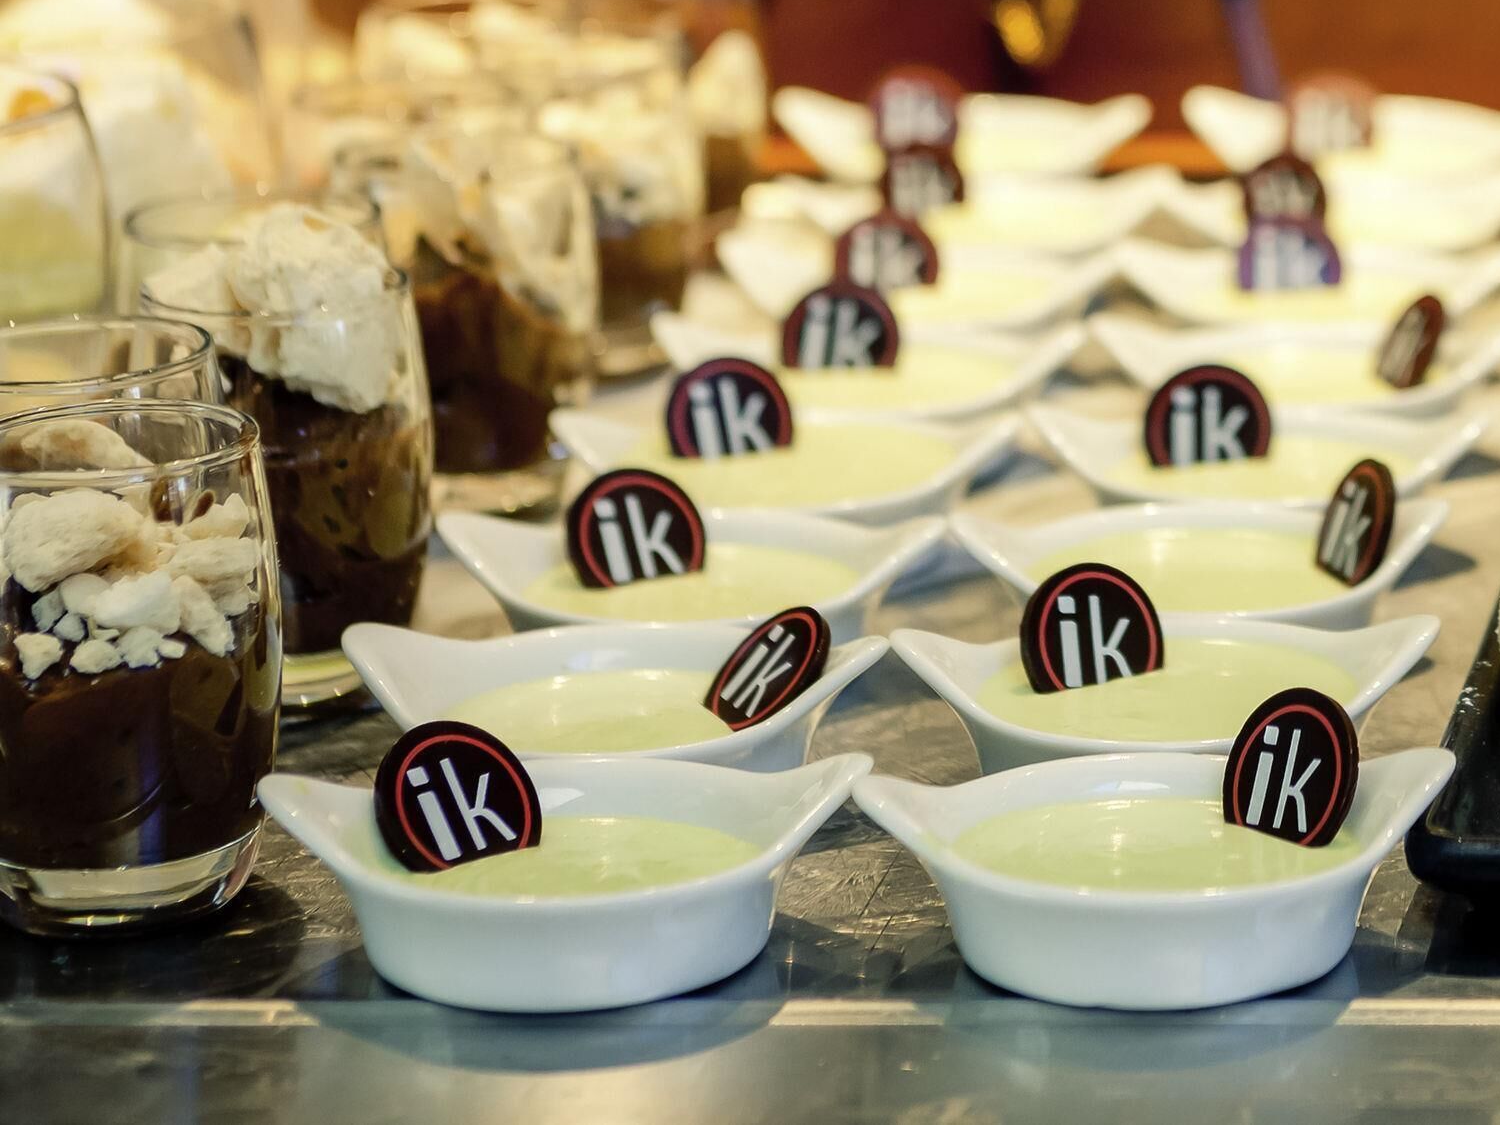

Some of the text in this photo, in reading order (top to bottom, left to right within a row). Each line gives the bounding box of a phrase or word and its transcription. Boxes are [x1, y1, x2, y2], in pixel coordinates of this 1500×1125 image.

[799, 293, 881, 367] ik
[687, 376, 774, 459] ik
[1170, 385, 1249, 466] ik
[593, 492, 684, 584] ik
[1321, 480, 1372, 578] ik
[720, 624, 796, 718] ik
[1057, 594, 1133, 687] ik
[406, 757, 517, 861] ik
[1246, 725, 1322, 833] ik
